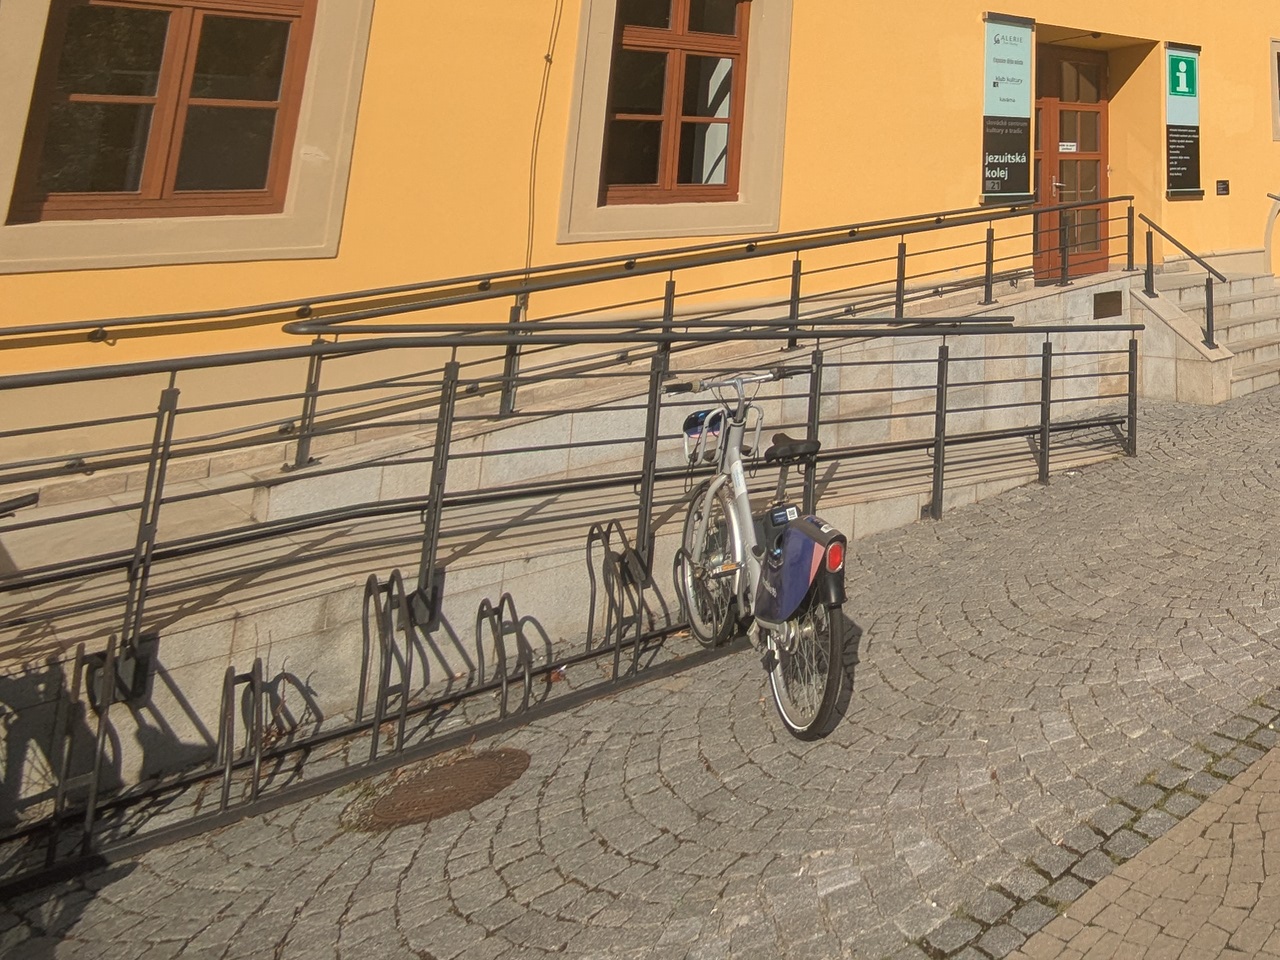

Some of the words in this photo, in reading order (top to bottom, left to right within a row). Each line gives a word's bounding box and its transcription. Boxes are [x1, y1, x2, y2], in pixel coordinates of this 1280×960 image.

[994, 34, 1023, 44] GALERIE
[985, 153, 1026, 165] jezuitská
[985, 167, 1008, 180] kolej
